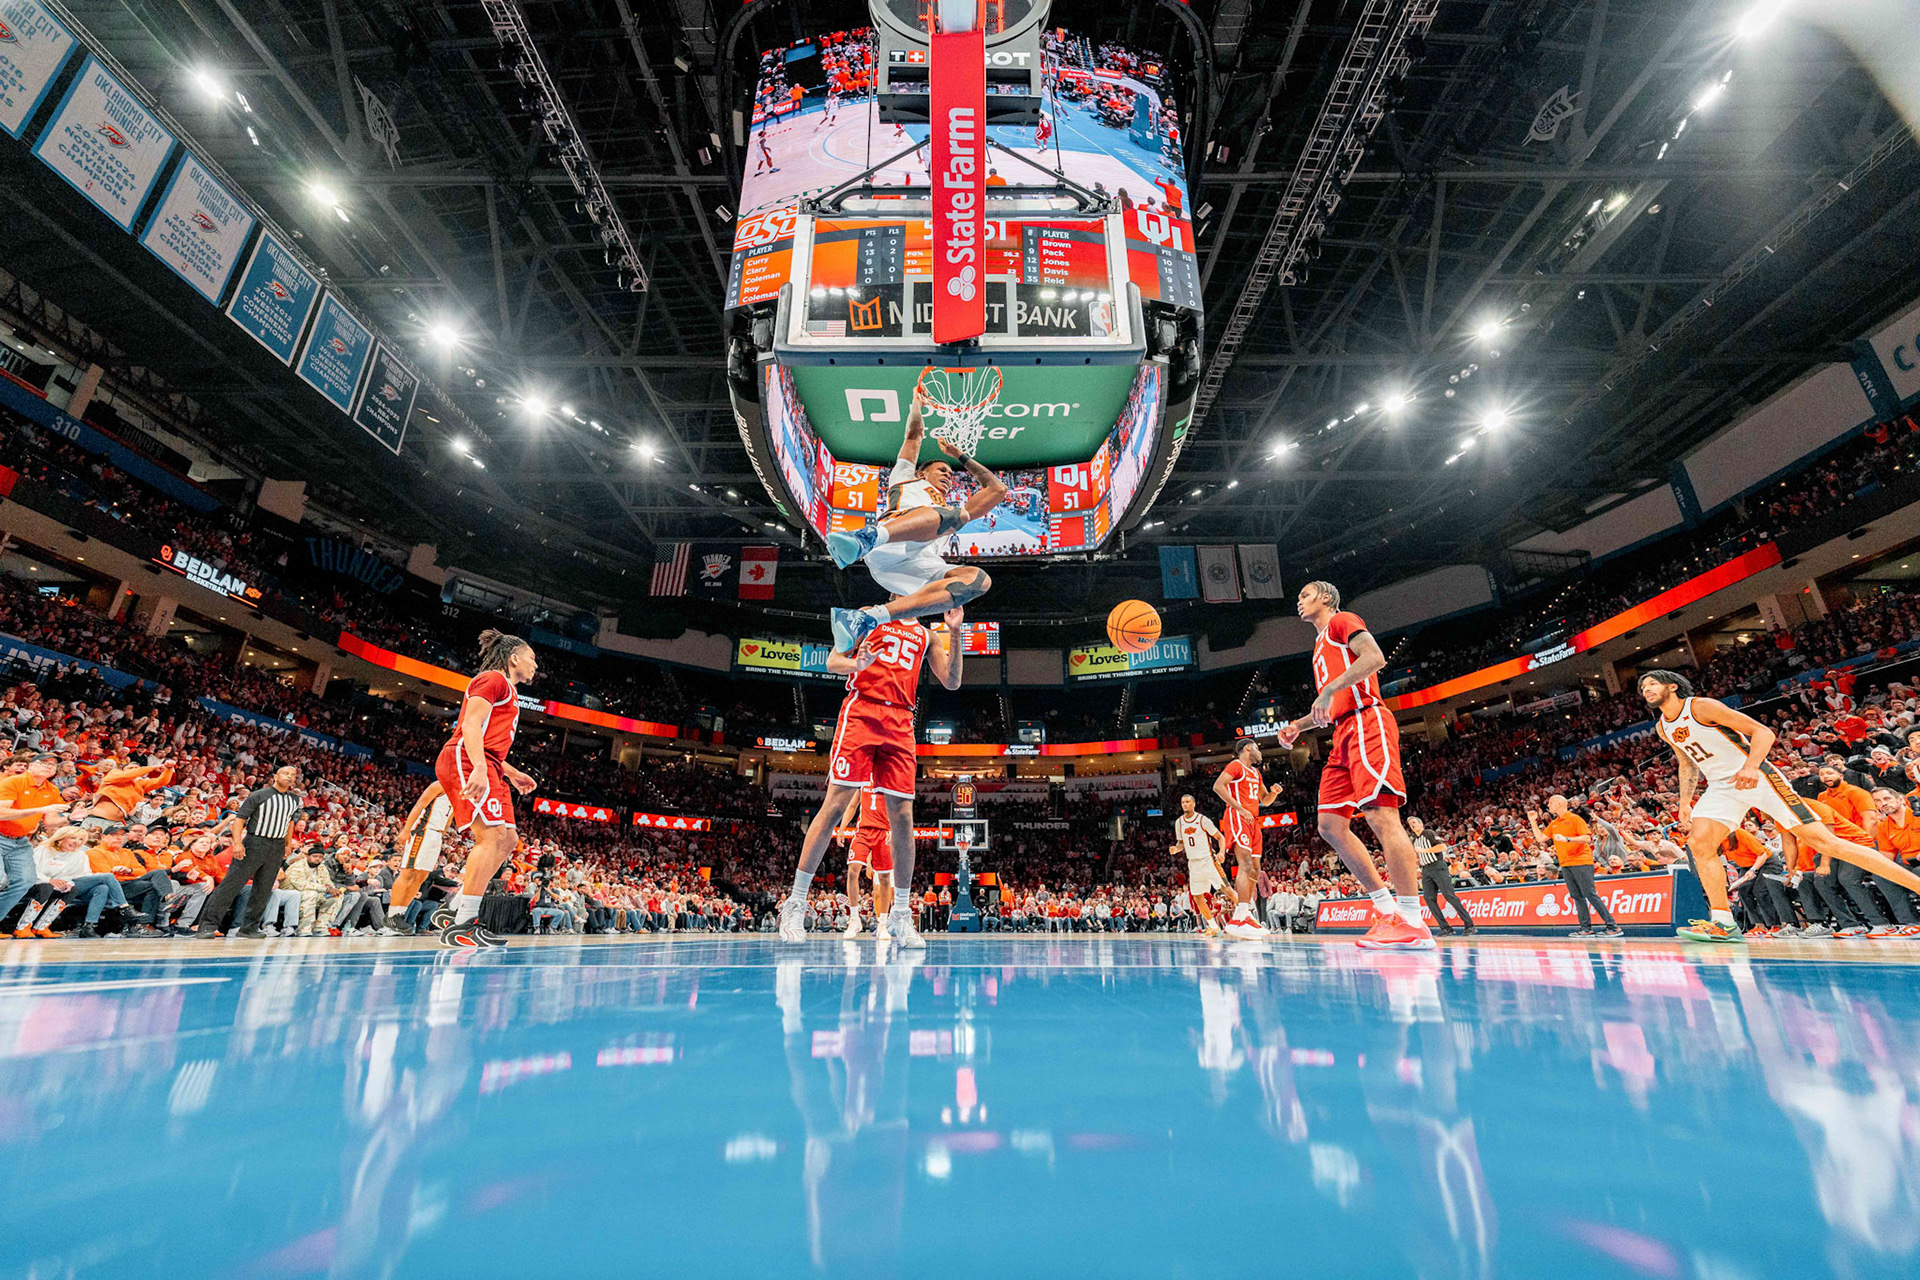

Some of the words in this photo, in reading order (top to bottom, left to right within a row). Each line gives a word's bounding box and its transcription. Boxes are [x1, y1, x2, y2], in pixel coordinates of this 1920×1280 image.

[35, 15, 61, 43] CITY
[985, 52, 1031, 67] SOT
[94, 74, 144, 123] OKLAHOMA
[144, 121, 164, 143] CITY
[104, 99, 145, 143] THUNDER
[64, 127, 136, 191] NORTHWEST
[74, 123, 136, 180] 2023-2024
[59, 143, 127, 205] CHAMPIONS
[72, 144, 123, 191] DIVISION
[189, 167, 230, 209] OKLAHOMA
[229, 206, 245, 225] CITY
[946, 106, 975, 264] StateFarm
[197, 190, 231, 227] THUNDER
[165, 218, 223, 271] NORTHWEST
[173, 214, 222, 261] 2024-2025
[1042, 230, 1070, 240] PLAYER
[1042, 240, 1072, 249] Brown
[159, 233, 215, 284] CHAMPIONS
[170, 232, 212, 271] DIVISION
[747, 256, 769, 267] Curry
[749, 245, 773, 257] PLAYER
[1042, 249, 1065, 257] Pack
[1182, 253, 1192, 262] FLS
[266, 242, 300, 279] OKLAHOMA
[298, 273, 312, 291] CITY
[746, 266, 767, 275] Clary
[1042, 258, 1070, 267] Jones
[1044, 267, 1069, 276] Davis
[1162, 258, 1173, 267] 10
[1164, 267, 1174, 275] 15
[271, 262, 300, 295] THUNDER
[744, 272, 780, 285] Coleman
[744, 285, 760, 294] Roy
[1027, 275, 1039, 283] 35
[1044, 276, 1065, 285] Reid
[254, 287, 292, 323] 2011-2012
[728, 299, 737, 307] 21
[742, 291, 779, 303] Coleman
[243, 295, 293, 341] CONFERENCE
[253, 295, 289, 329] WESTERN
[1016, 302, 1077, 329] BANK
[242, 304, 288, 345] CHAMPIONS
[328, 303, 355, 333] OKLAHOMA
[354, 327, 366, 344] CITY
[334, 320, 357, 347] THUNDER
[309, 354, 351, 392] CONFERENCE
[318, 352, 348, 381] WESTERN
[380, 352, 403, 380] OKLAHOMA
[401, 373, 413, 389] CITY
[309, 362, 348, 396] CHAMPIONS
[385, 368, 404, 393] THUNDER
[1859, 371, 1878, 399] 322
[365, 405, 398, 435] CHAMPIONS
[377, 407, 390, 421] NBA
[909, 402, 1070, 421] pacom
[51, 415, 81, 441] 310
[820, 474, 829, 498] 51
[1098, 475, 1106, 498] 51
[848, 491, 864, 509] 51
[1063, 491, 1079, 510] 51
[173, 550, 247, 597] BEDLAM
[304, 536, 404, 595] THUNDER
[186, 573, 229, 597] BASKETBALL
[441, 605, 460, 619] 312
[559, 638, 573, 650] 313
[881, 625, 923, 645] OKLAHOMA
[803, 650, 828, 667] LOU
[878, 634, 919, 671] 35
[1164, 643, 1189, 663] CITY
[1539, 646, 1576, 666] StateFarm
[782, 669, 813, 678] THUNDER
[1112, 669, 1143, 678] THUNDER
[230, 713, 345, 756] BASKTBALL
[1244, 721, 1289, 735] BEDLAM
[1672, 726, 1691, 743] OSU
[764, 738, 806, 749] BEDLAM
[1683, 741, 1714, 763] 21
[835, 756, 850, 778] OU
[957, 793, 973, 805] 30
[1248, 783, 1258, 800] 12
[1768, 773, 1800, 807] COWBOYS
[487, 798, 502, 818] OU
[870, 794, 877, 811] 1
[1304, 806, 1315, 814] 112
[1013, 822, 1070, 831] THUNDER
[1188, 837, 1195, 846] 0
[1330, 907, 1368, 921] StateFarm
[1461, 897, 1526, 918] StateFarm
